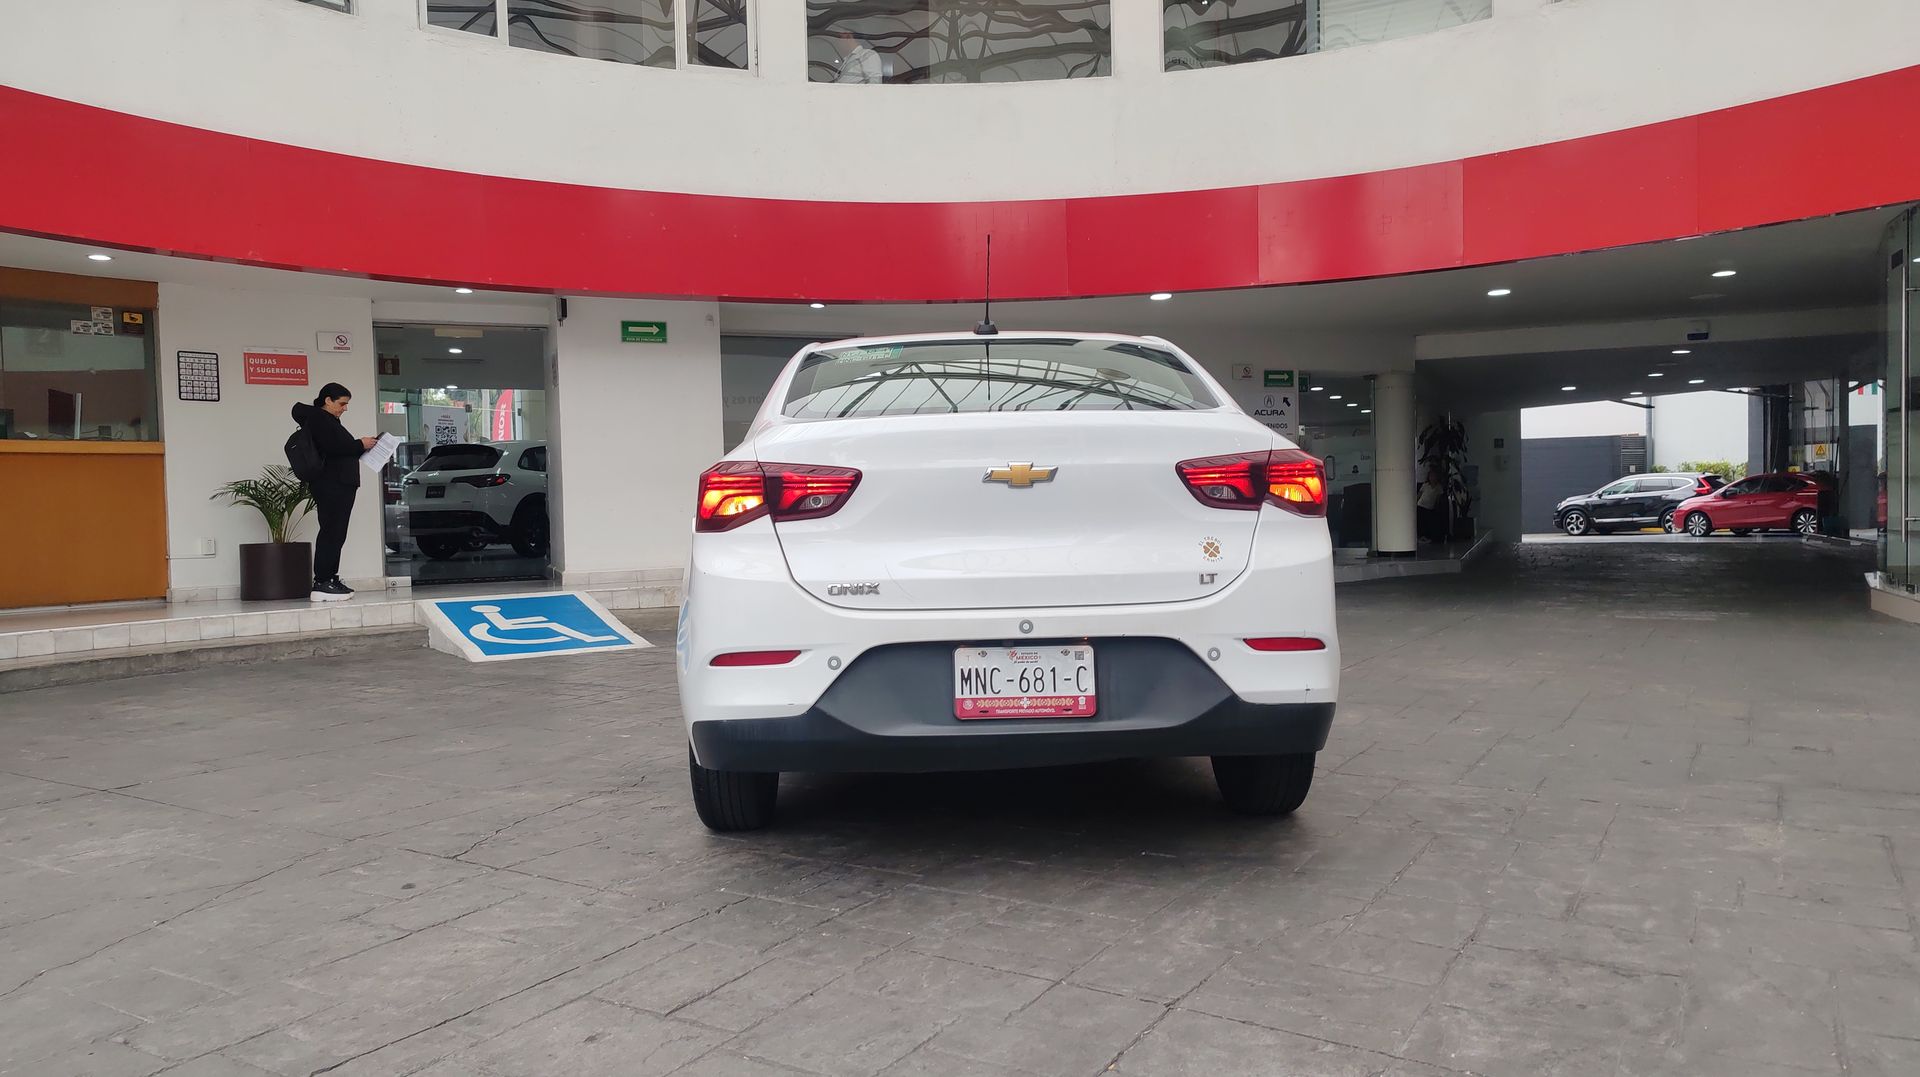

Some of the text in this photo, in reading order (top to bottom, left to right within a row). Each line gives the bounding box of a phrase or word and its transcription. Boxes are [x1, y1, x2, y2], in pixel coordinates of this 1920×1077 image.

[249, 358, 277, 366] QUEJAS
[256, 367, 306, 375] SUGERENCIAS
[498, 401, 507, 441] HON
[1199, 573, 1218, 585] LT
[827, 582, 880, 596] ONIX
[960, 666, 1088, 695] MNC-681-C
